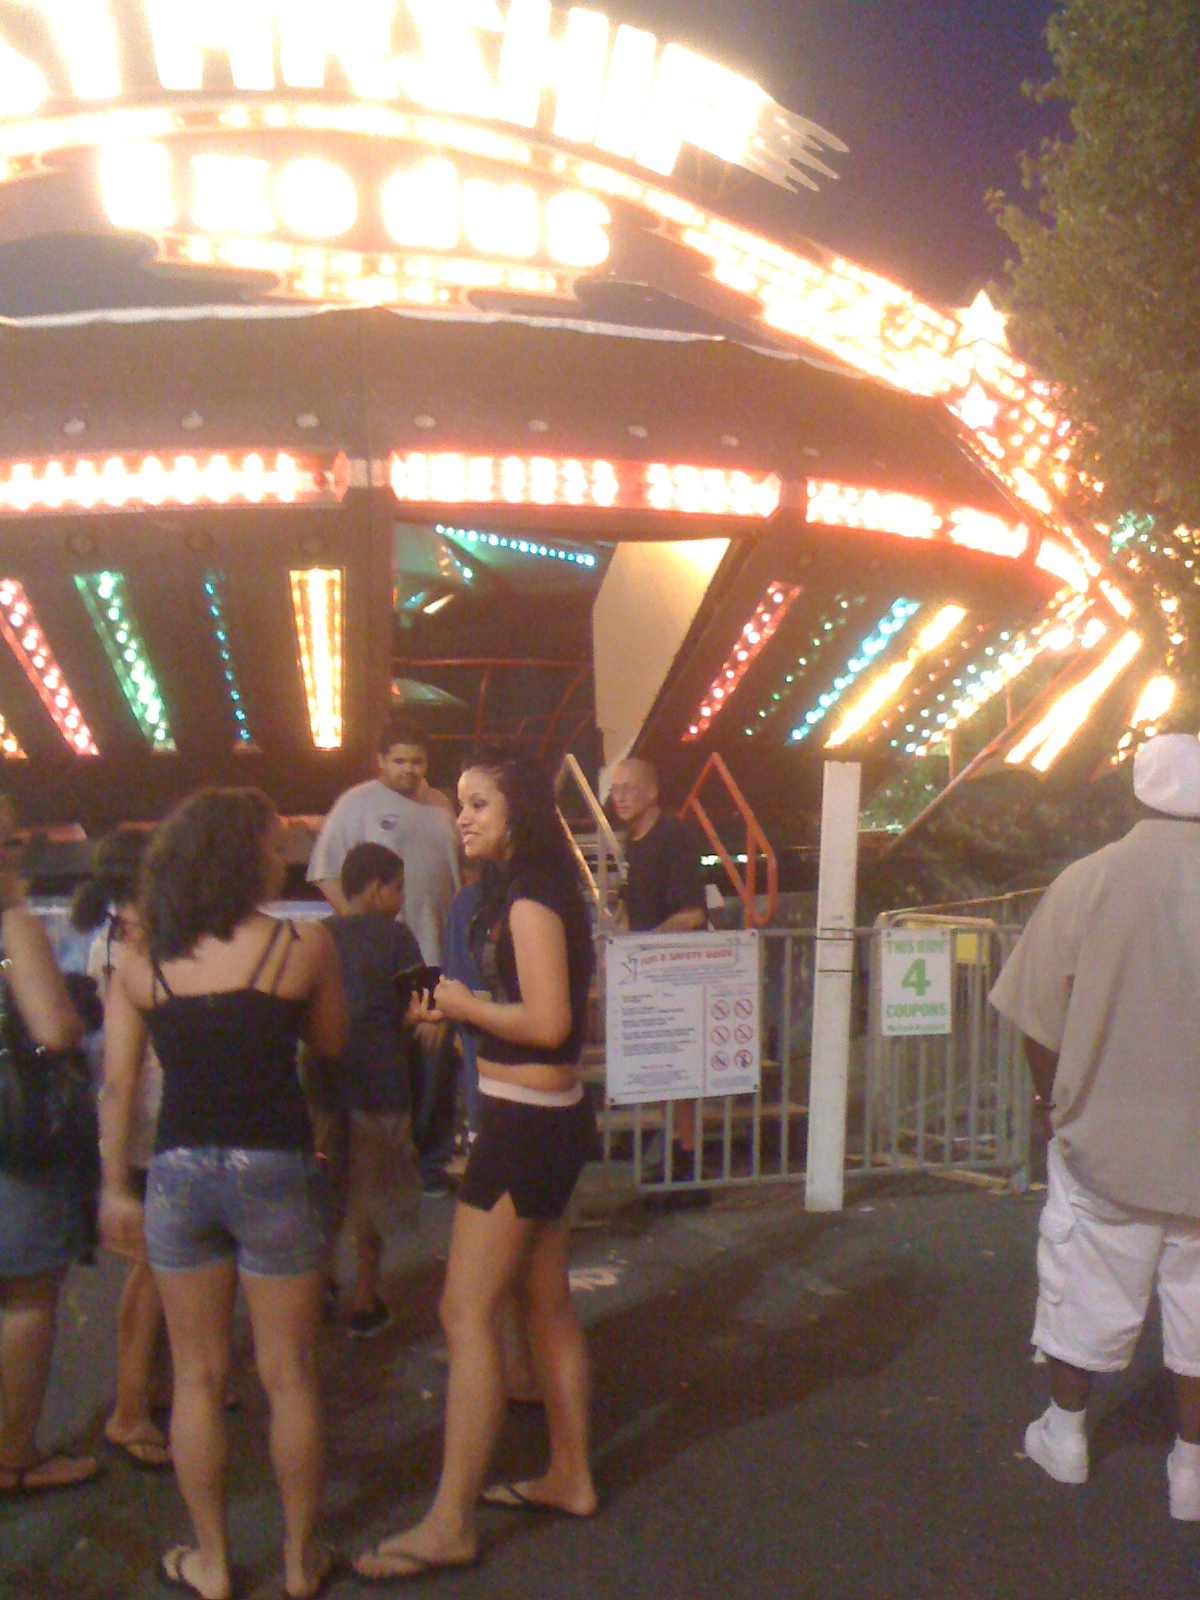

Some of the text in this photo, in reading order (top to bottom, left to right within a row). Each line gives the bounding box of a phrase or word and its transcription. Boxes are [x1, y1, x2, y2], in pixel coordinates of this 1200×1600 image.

[886, 940, 946, 954] THIS RIDE
[901, 958, 932, 997] 4
[886, 1003, 947, 1018] COUPONS
